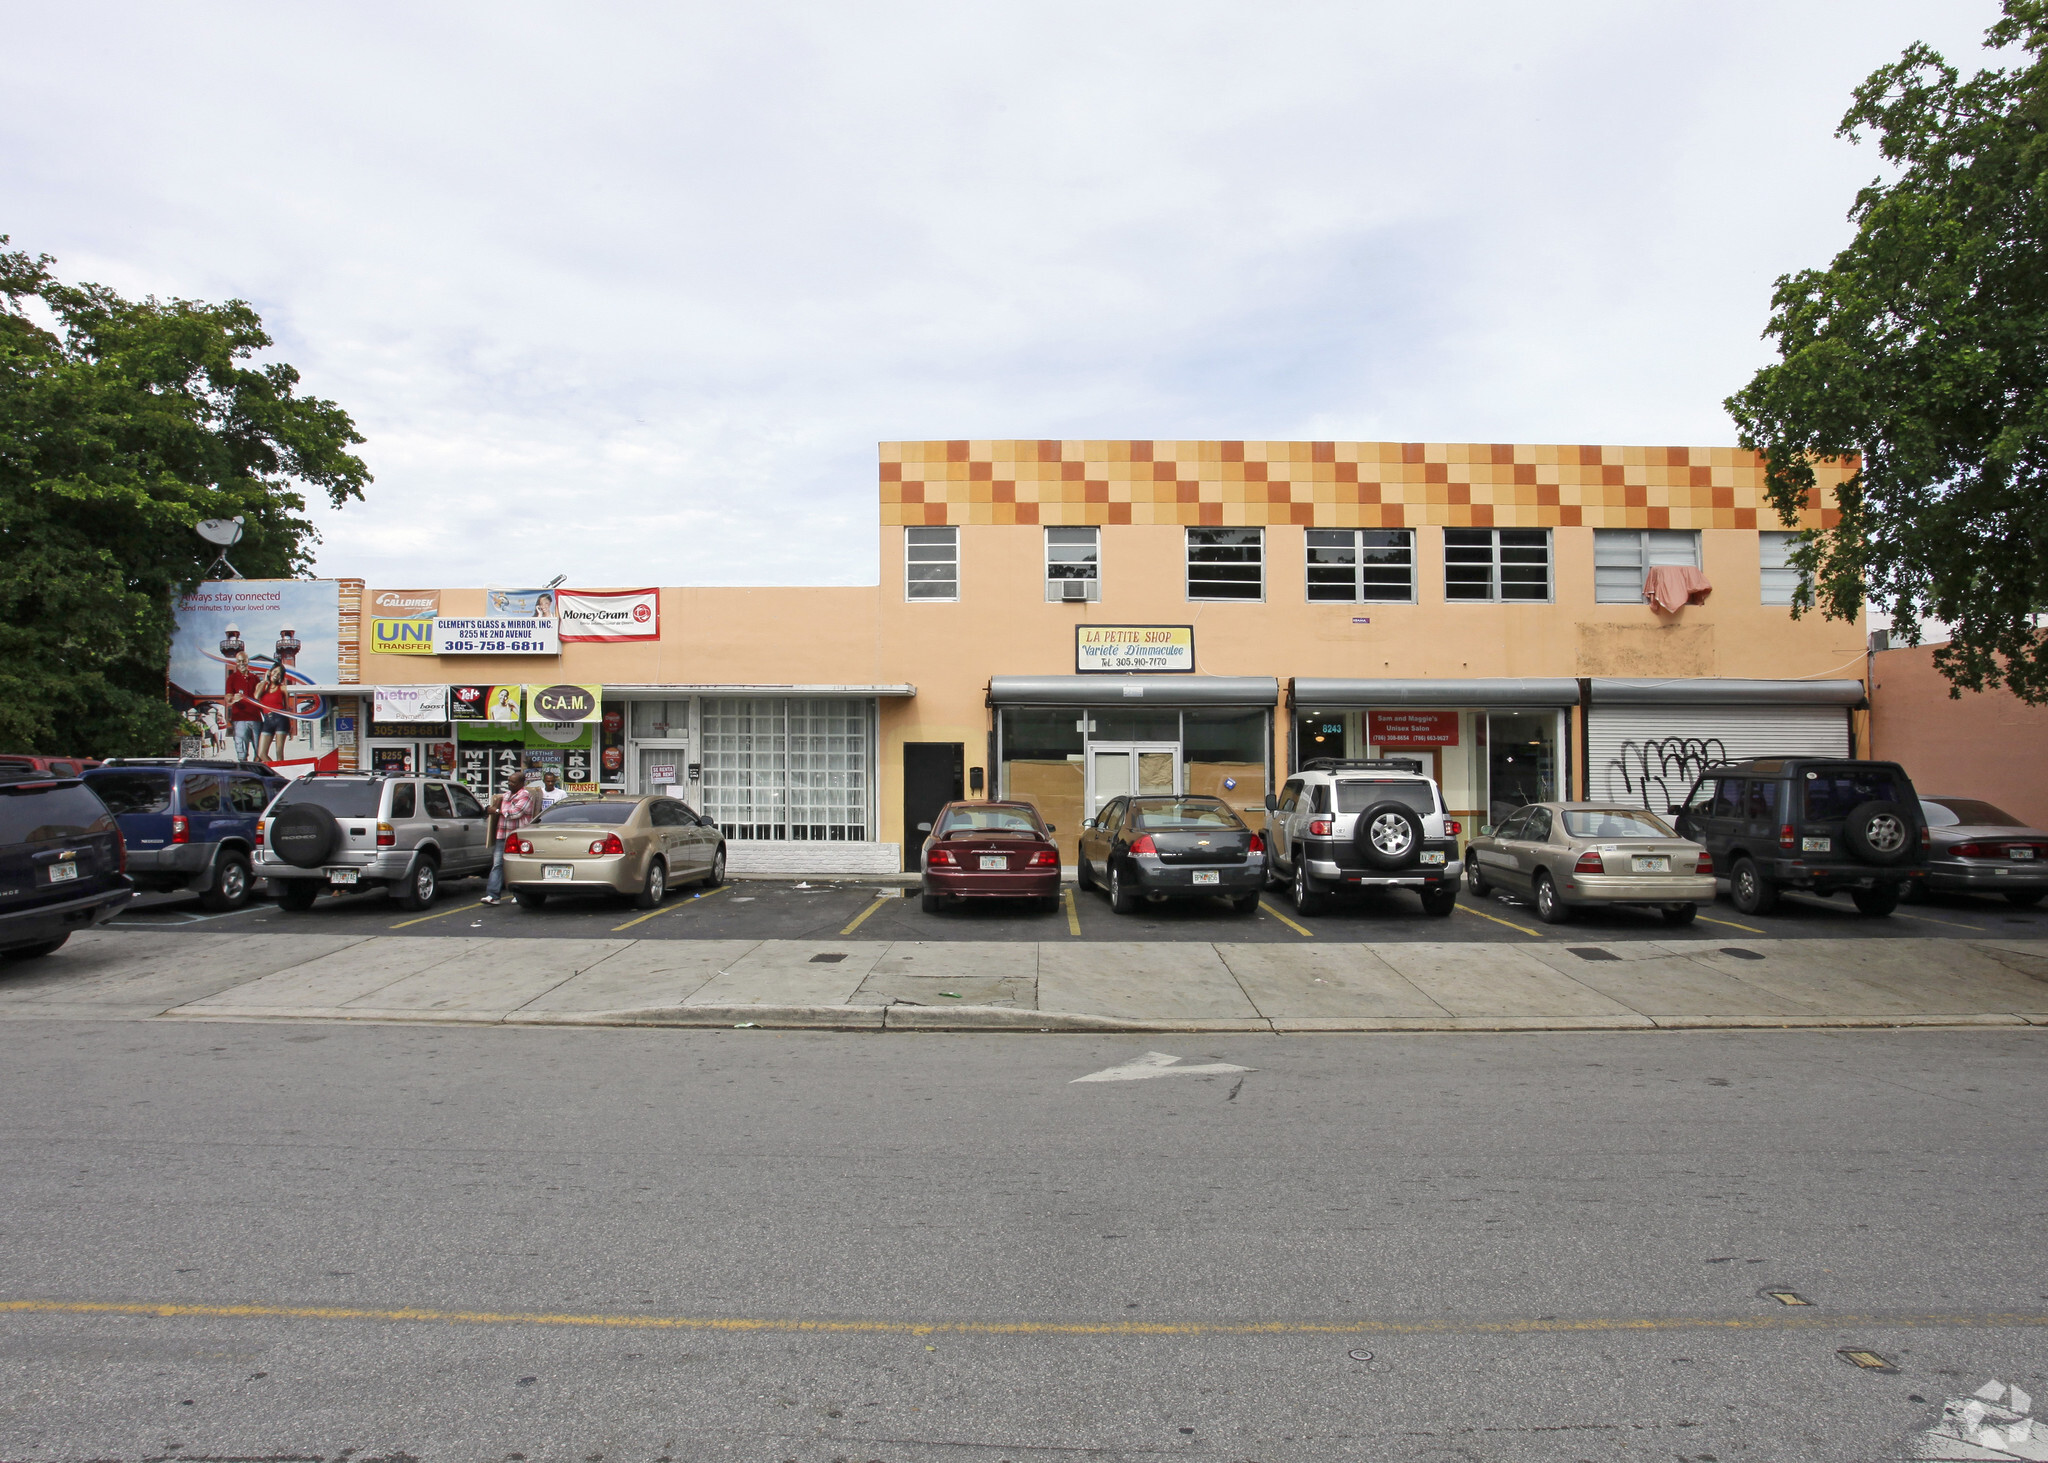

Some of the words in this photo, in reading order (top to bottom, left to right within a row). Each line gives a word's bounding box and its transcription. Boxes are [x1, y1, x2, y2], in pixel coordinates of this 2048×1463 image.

[215, 592, 232, 603] stay
[235, 591, 281, 600] connected
[563, 610, 629, 621] MoneyGram
[438, 620, 476, 629] CLEMENT'S
[477, 620, 499, 629] GLASS
[500, 621, 506, 629] &
[507, 620, 537, 630] MIRROR,
[538, 621, 553, 629] INC.
[377, 622, 432, 641] UNI
[459, 630, 478, 638] 8255
[479, 630, 489, 638] NE
[489, 630, 504, 638] 2ND
[505, 630, 532, 638] AVENUE
[1086, 631, 1100, 642] LA
[1104, 631, 1140, 643] PETITE
[1145, 631, 1172, 643] SHOP
[445, 641, 545, 651] 305-758-6811
[542, 696, 588, 710] C.A.M.
[1408, 715, 1438, 723] Maggie's
[374, 725, 446, 736] 305-758-6811
[1322, 724, 1342, 734] 8243
[381, 751, 402, 760] 8255
